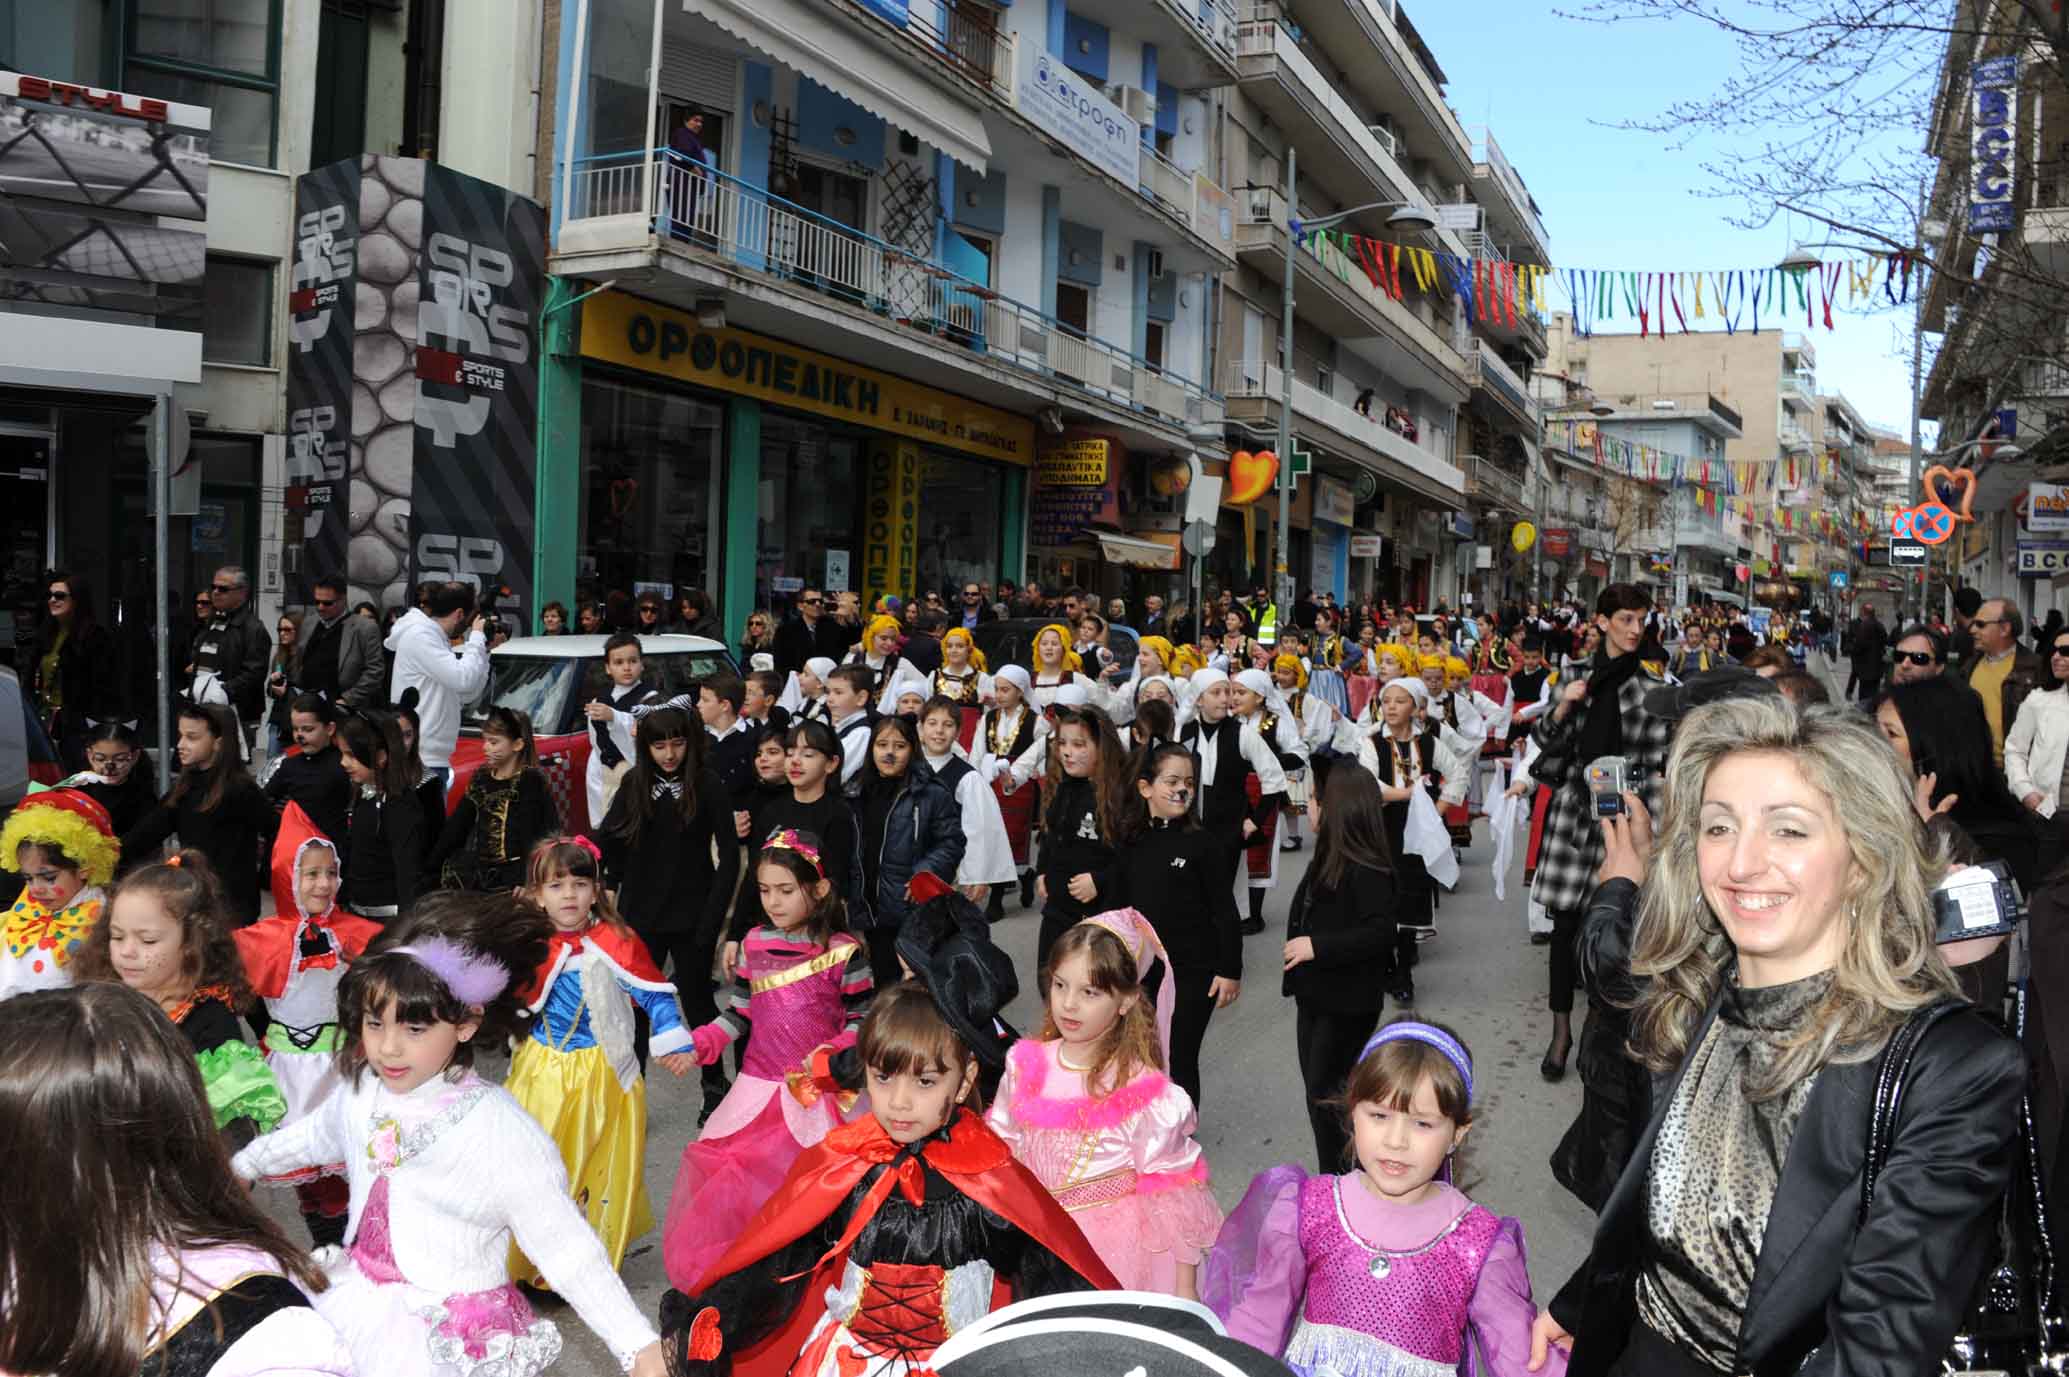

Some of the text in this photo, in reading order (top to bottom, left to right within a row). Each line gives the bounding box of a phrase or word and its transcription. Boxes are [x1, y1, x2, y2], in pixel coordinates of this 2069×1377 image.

[18, 75, 169, 124] STYLE
[463, 360, 505, 379] SPORTS
[627, 313, 881, 415] ΟΡΘΟΠΕΔΙΚΗ
[466, 373, 505, 391] STYLE
